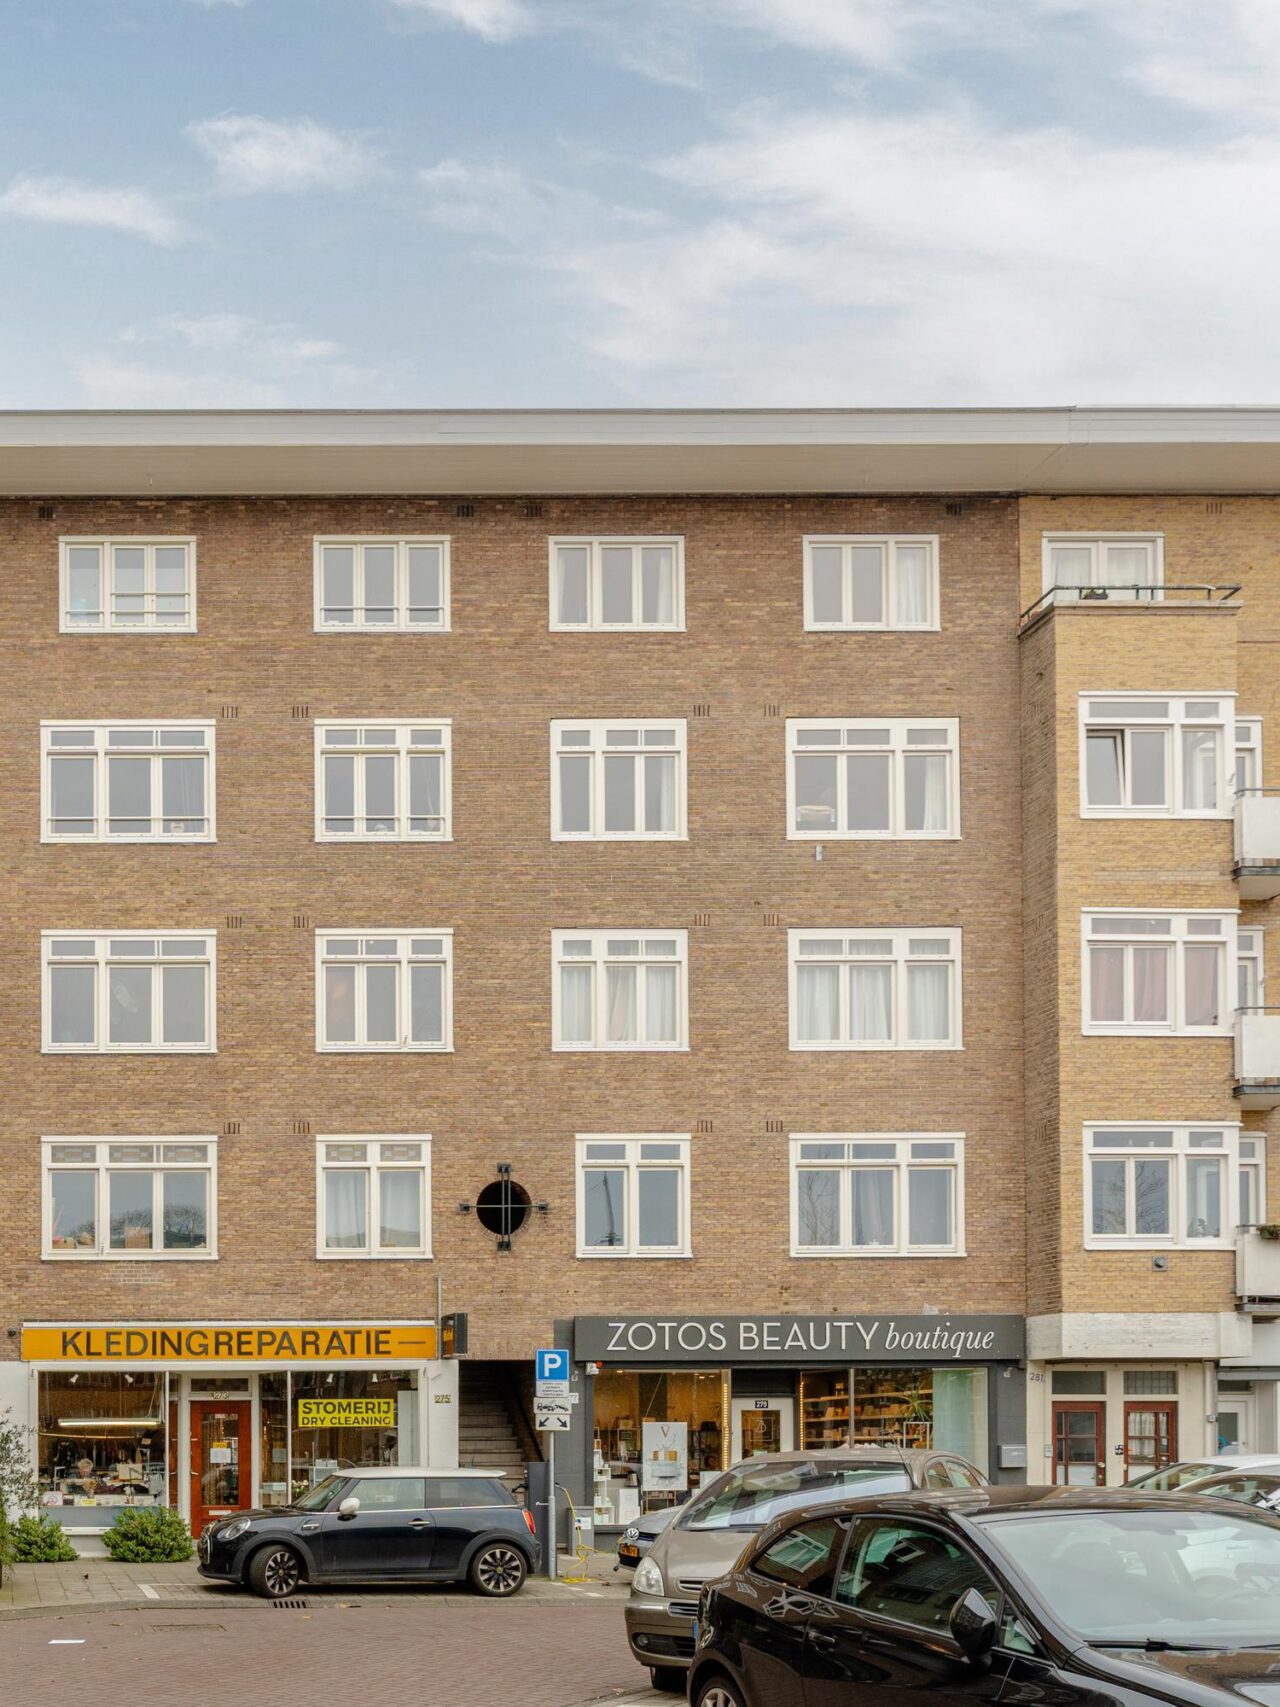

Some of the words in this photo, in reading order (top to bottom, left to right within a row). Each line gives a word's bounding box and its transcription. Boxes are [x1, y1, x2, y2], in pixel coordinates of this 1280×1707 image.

[61, 1330, 392, 1357] KLEDINGREPARATIE
[607, 1322, 728, 1351] ZOTOS
[739, 1322, 879, 1350] BEAUTY
[885, 1322, 995, 1358] boutique
[544, 1353, 562, 1377] P
[434, 1394, 452, 1404] 275
[756, 1400, 768, 1408] 279
[302, 1401, 391, 1414] STOMERIJ
[301, 1416, 326, 1425] DRY
[329, 1416, 391, 1425] CLEANING
